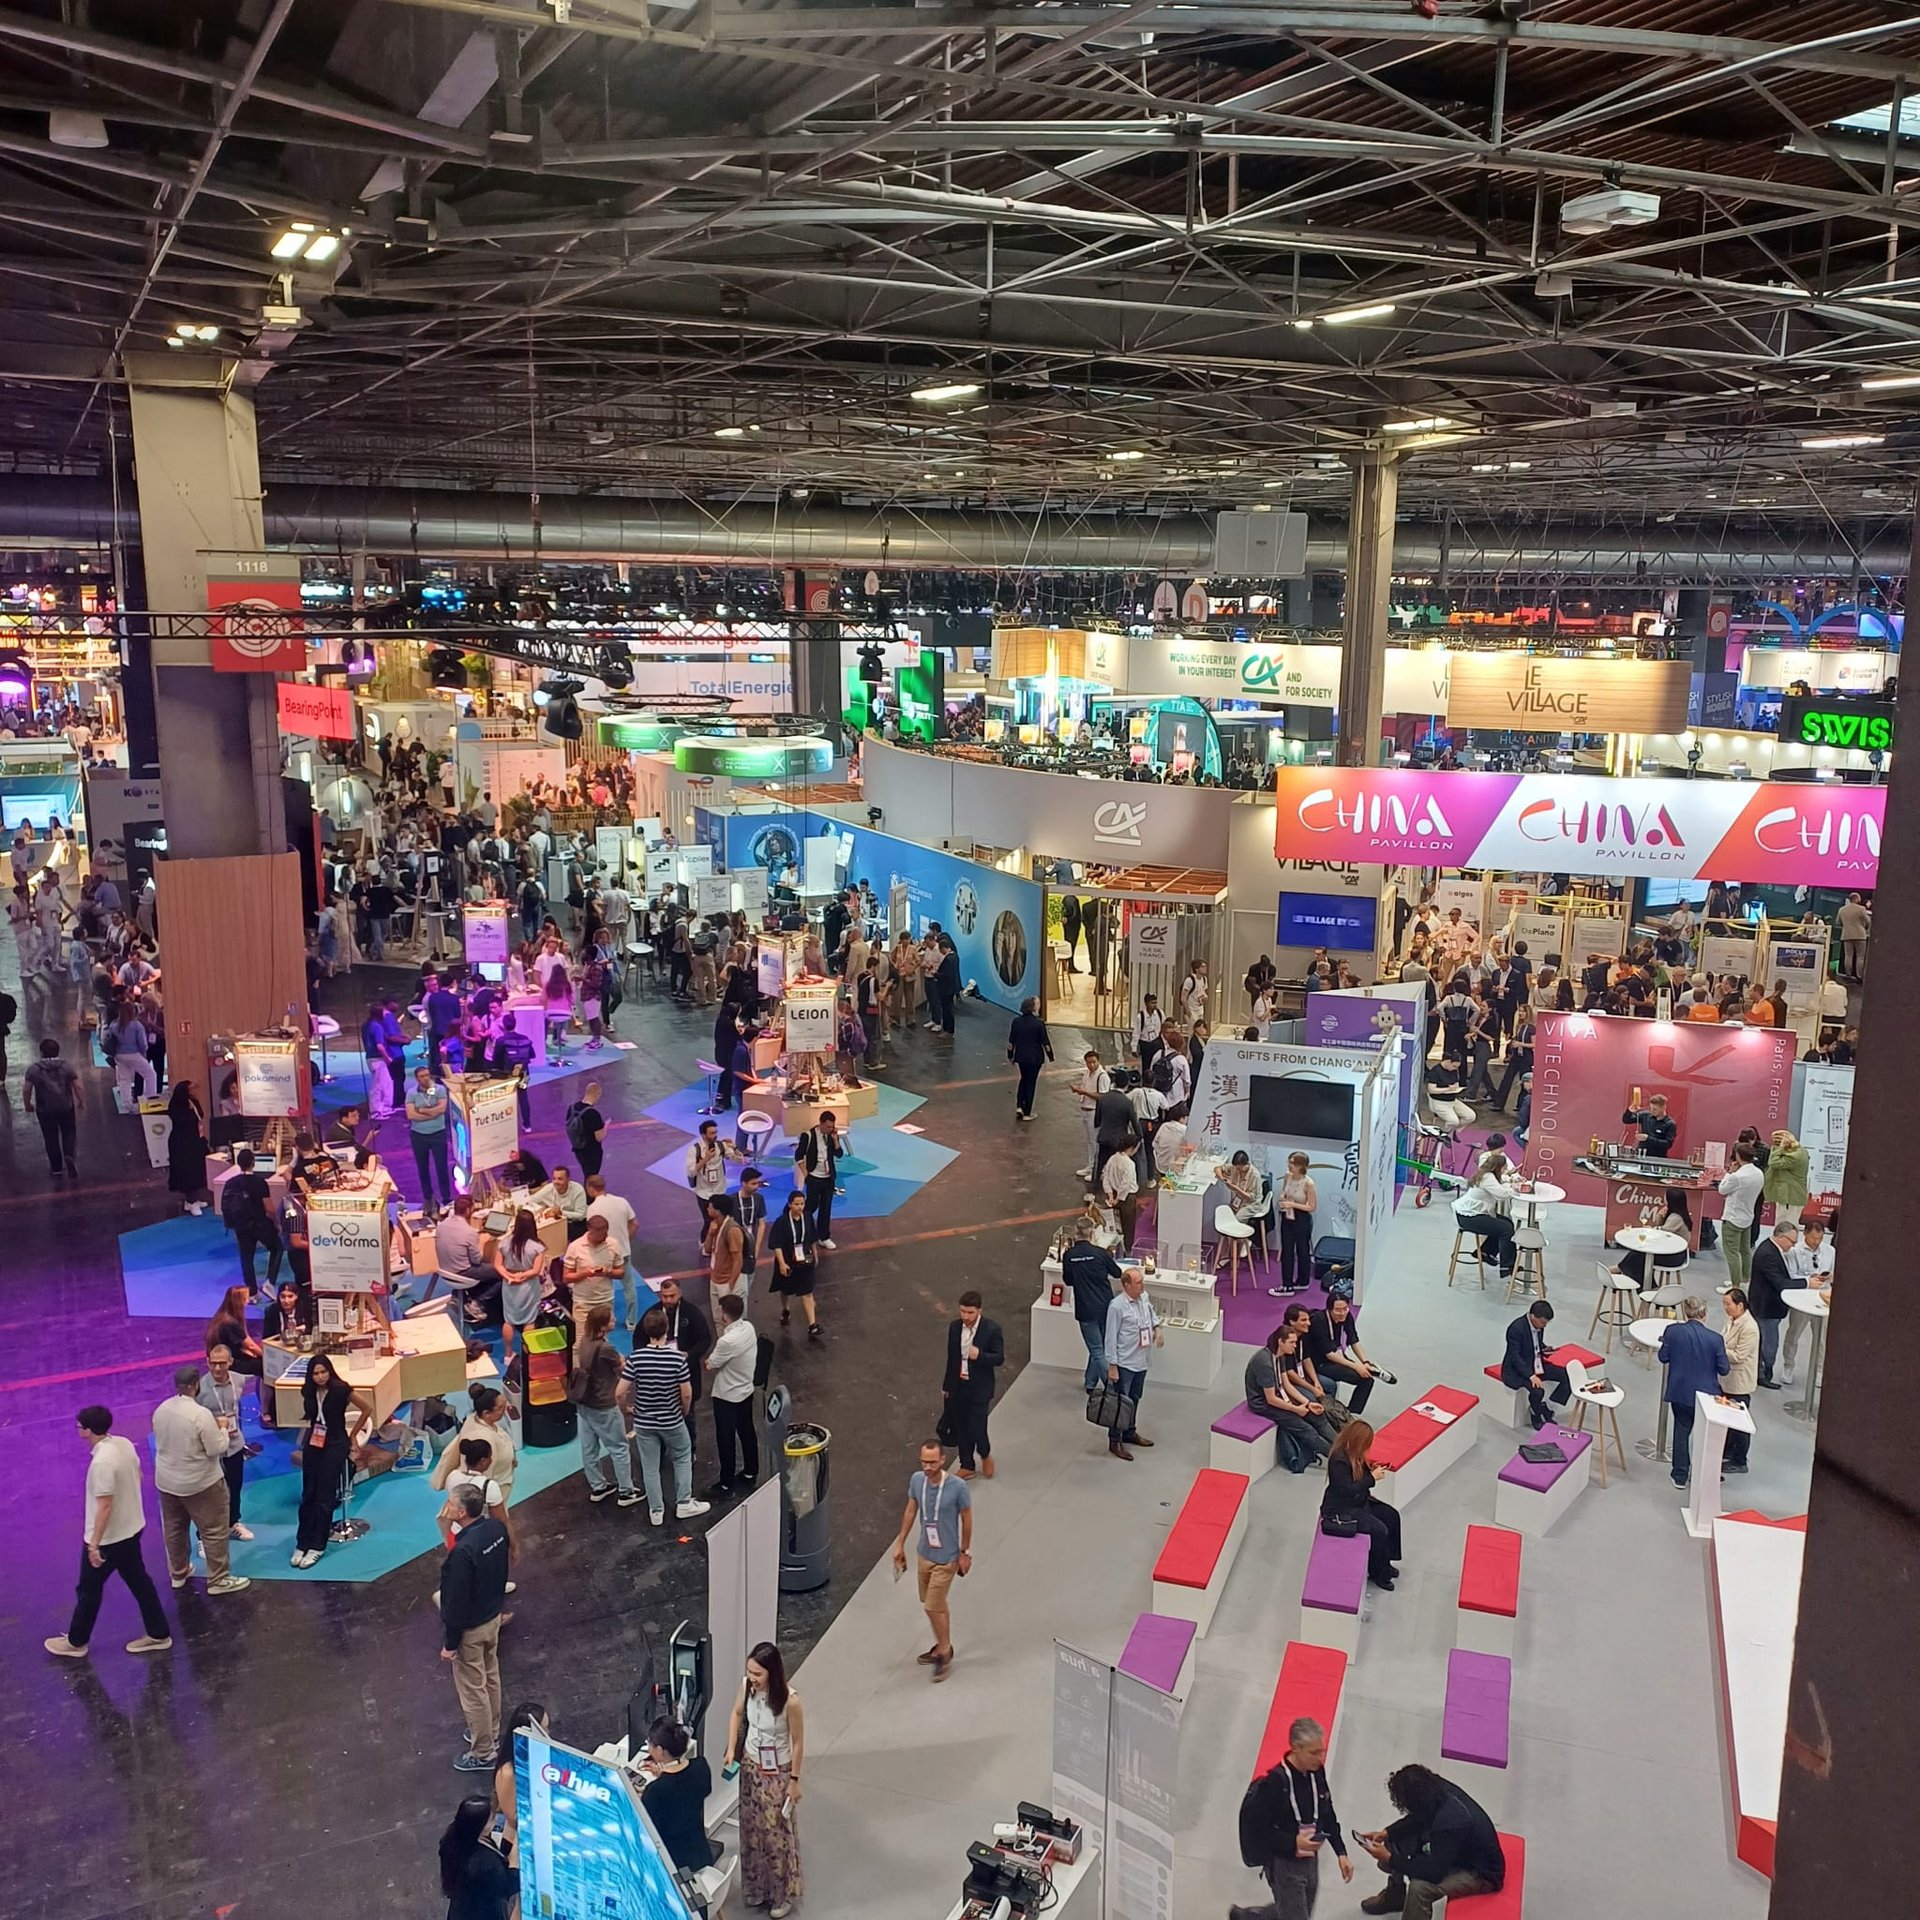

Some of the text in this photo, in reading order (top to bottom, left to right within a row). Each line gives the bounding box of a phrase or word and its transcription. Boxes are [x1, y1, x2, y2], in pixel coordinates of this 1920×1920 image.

[236, 561, 268, 573] 1118
[1169, 652, 1237, 665] WORKING EVERY DAY
[1178, 666, 1236, 679] IN YOUR INTEREST
[1286, 671, 1302, 682] AND
[1524, 665, 1543, 690] LE
[1286, 686, 1333, 699] FOR SOCIETY
[1706, 691, 1734, 705] STYLISH
[1506, 687, 1589, 714] VILLAGE
[285, 698, 342, 720] BearingPoint
[1298, 788, 1453, 837] CHINA
[1518, 798, 1685, 847] CHINA
[1370, 838, 1454, 850] PAVILLON
[1595, 849, 1686, 861] PAVILLON
[790, 1008, 829, 1020] LEION
[1544, 1020, 1597, 1040] VIVA
[1237, 1050, 1270, 1062] GIFTS
[1273, 1053, 1307, 1065] FROM
[1211, 1074, 1239, 1097] 漢
[1768, 1038, 1787, 1120] Paris, France
[1202, 1111, 1223, 1136] 唐
[1615, 1183, 1664, 1206] China
[312, 1233, 380, 1248] devforma
